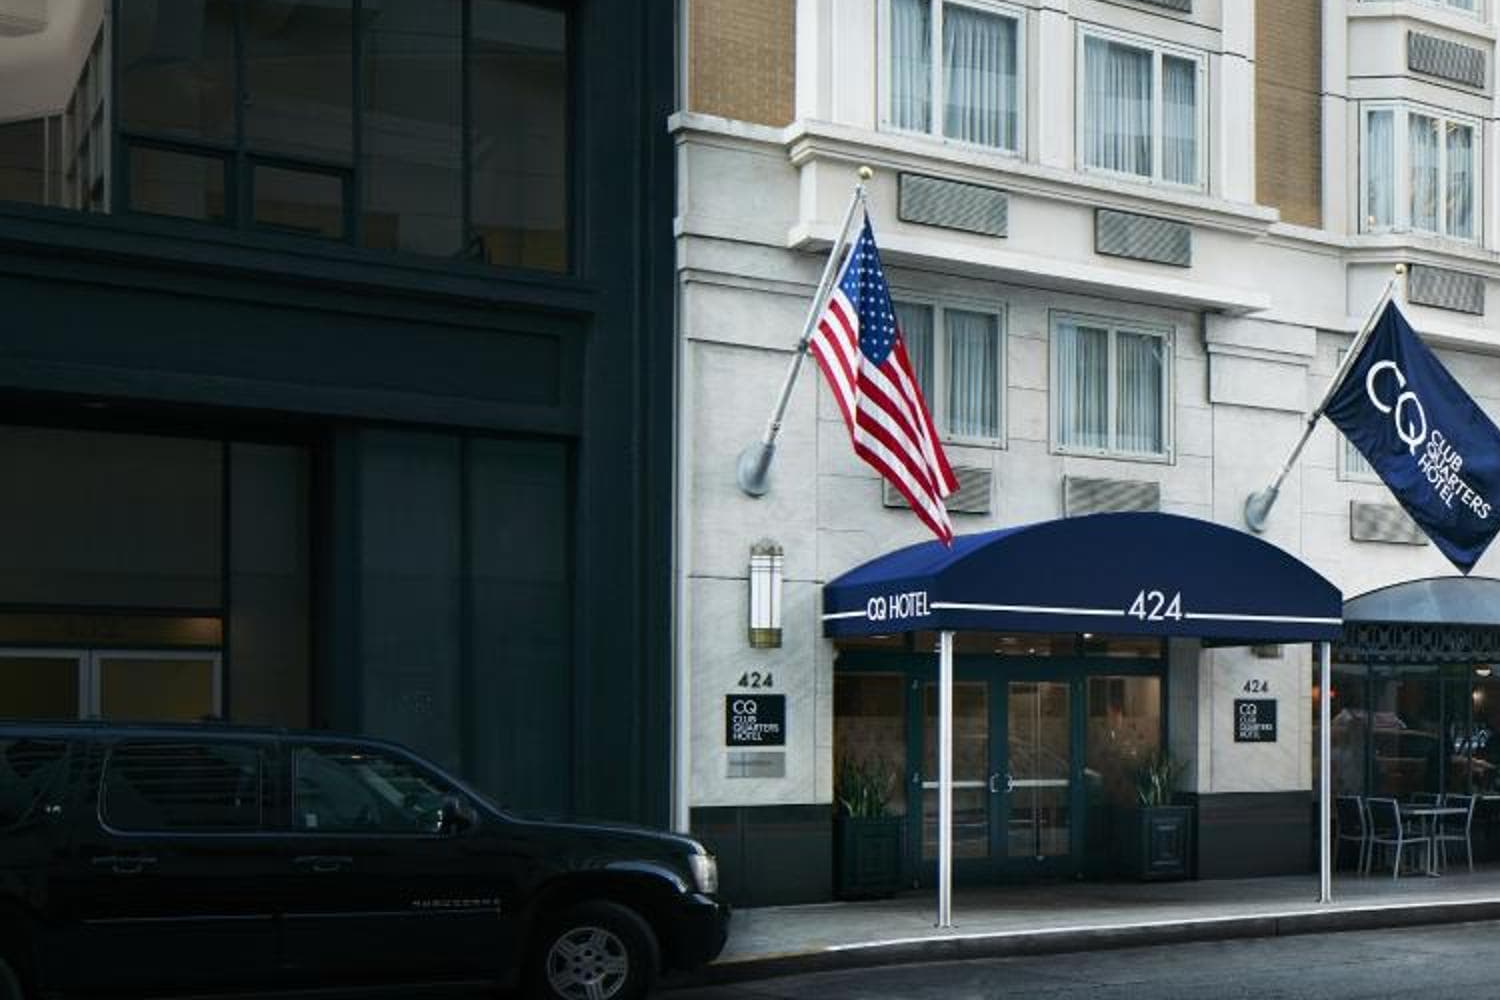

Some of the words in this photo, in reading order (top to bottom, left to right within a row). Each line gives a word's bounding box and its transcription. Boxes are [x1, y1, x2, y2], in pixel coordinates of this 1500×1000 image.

[1366, 360, 1428, 456] CQ
[1431, 430, 1463, 470] CLUB
[1418, 453, 1455, 509] HOTEL
[1426, 441, 1492, 519] QUARTERS
[867, 596, 887, 621] CQ
[889, 591, 931, 619] HOTEL
[1128, 590, 1182, 621] 424
[737, 671, 774, 688] 424
[1243, 680, 1269, 692] 424
[733, 700, 758, 715] CQ
[733, 723, 780, 733] QUARTERS
[733, 732, 763, 741] HOTEL
